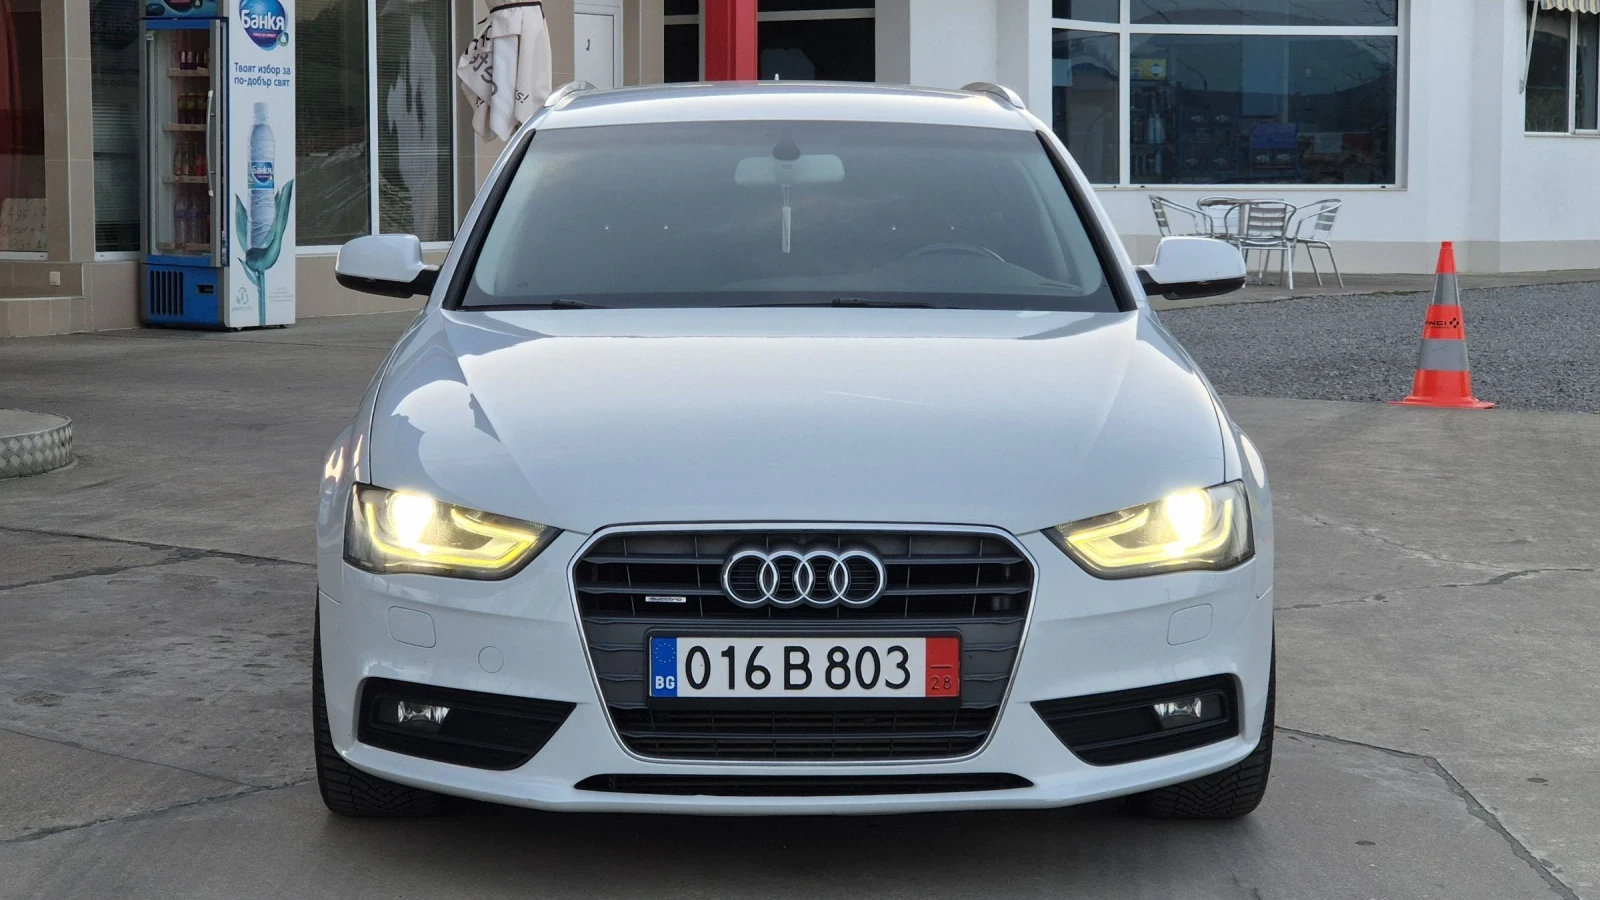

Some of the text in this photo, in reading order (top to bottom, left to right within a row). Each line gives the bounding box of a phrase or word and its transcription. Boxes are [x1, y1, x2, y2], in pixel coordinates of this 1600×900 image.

[234, 62, 291, 77] Твоят избор за
[234, 76, 290, 88] по-добър свят
[655, 676, 675, 689] BG
[931, 675, 952, 690] 28
